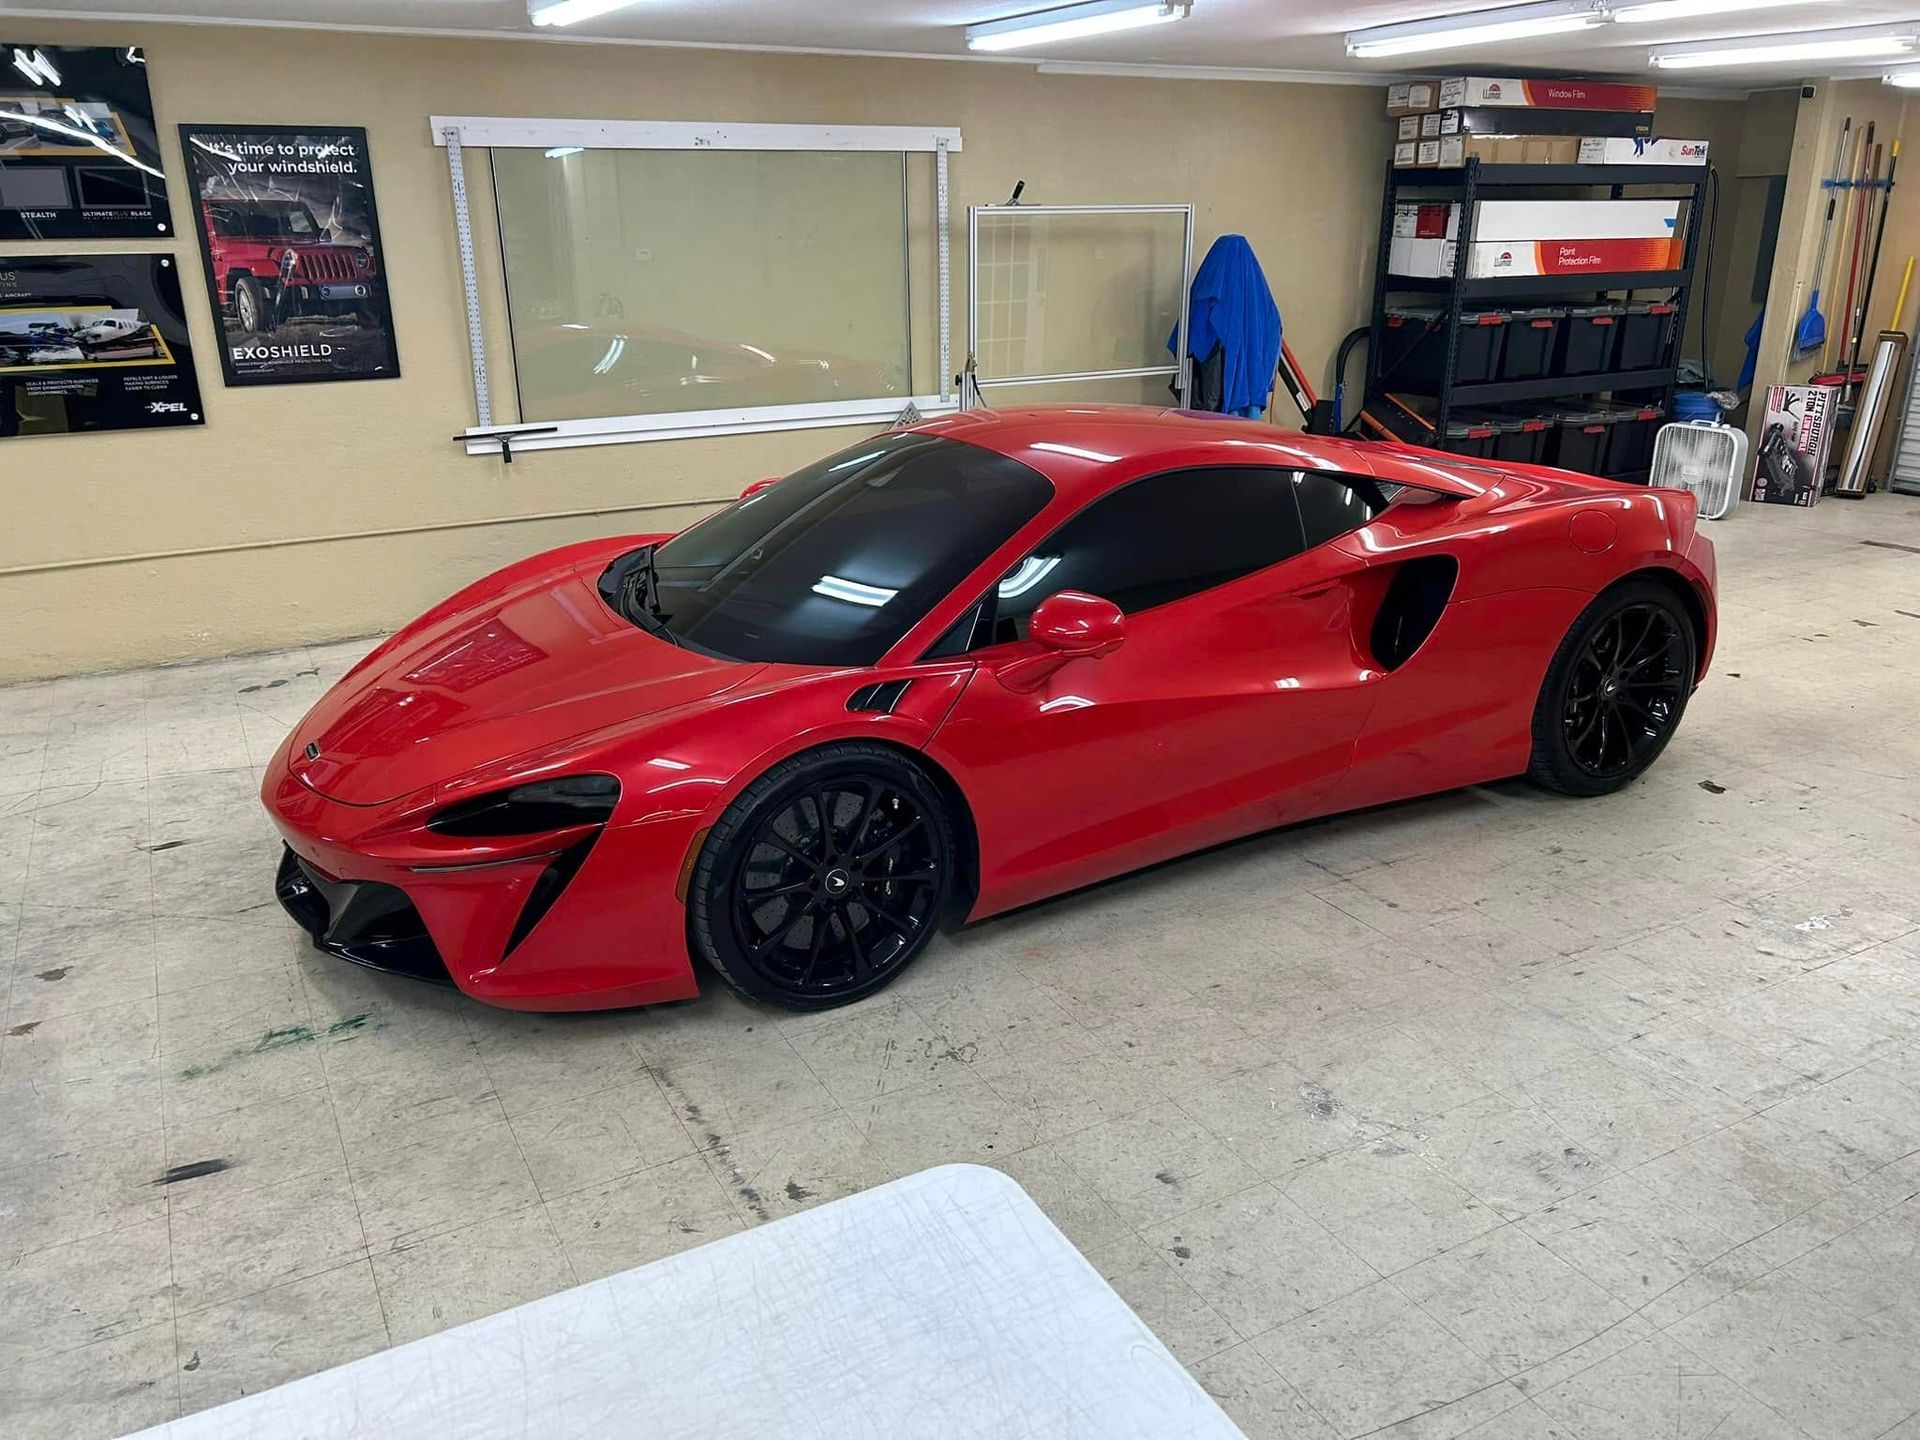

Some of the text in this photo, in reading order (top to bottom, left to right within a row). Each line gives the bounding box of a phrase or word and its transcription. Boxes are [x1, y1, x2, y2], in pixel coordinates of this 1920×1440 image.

[1548, 88, 1586, 98] Window Film
[237, 142, 274, 155] time
[277, 143, 294, 155] to
[299, 144, 355, 158] protect
[1681, 145, 1707, 157] SunTek
[227, 160, 358, 175] your windshield.
[1560, 247, 1576, 256] Paint
[1558, 255, 1602, 266] Protection Film
[233, 344, 332, 360] EXOSHIELD
[151, 402, 187, 413] XPEL
[1807, 391, 1827, 456] PITTSBURGH
